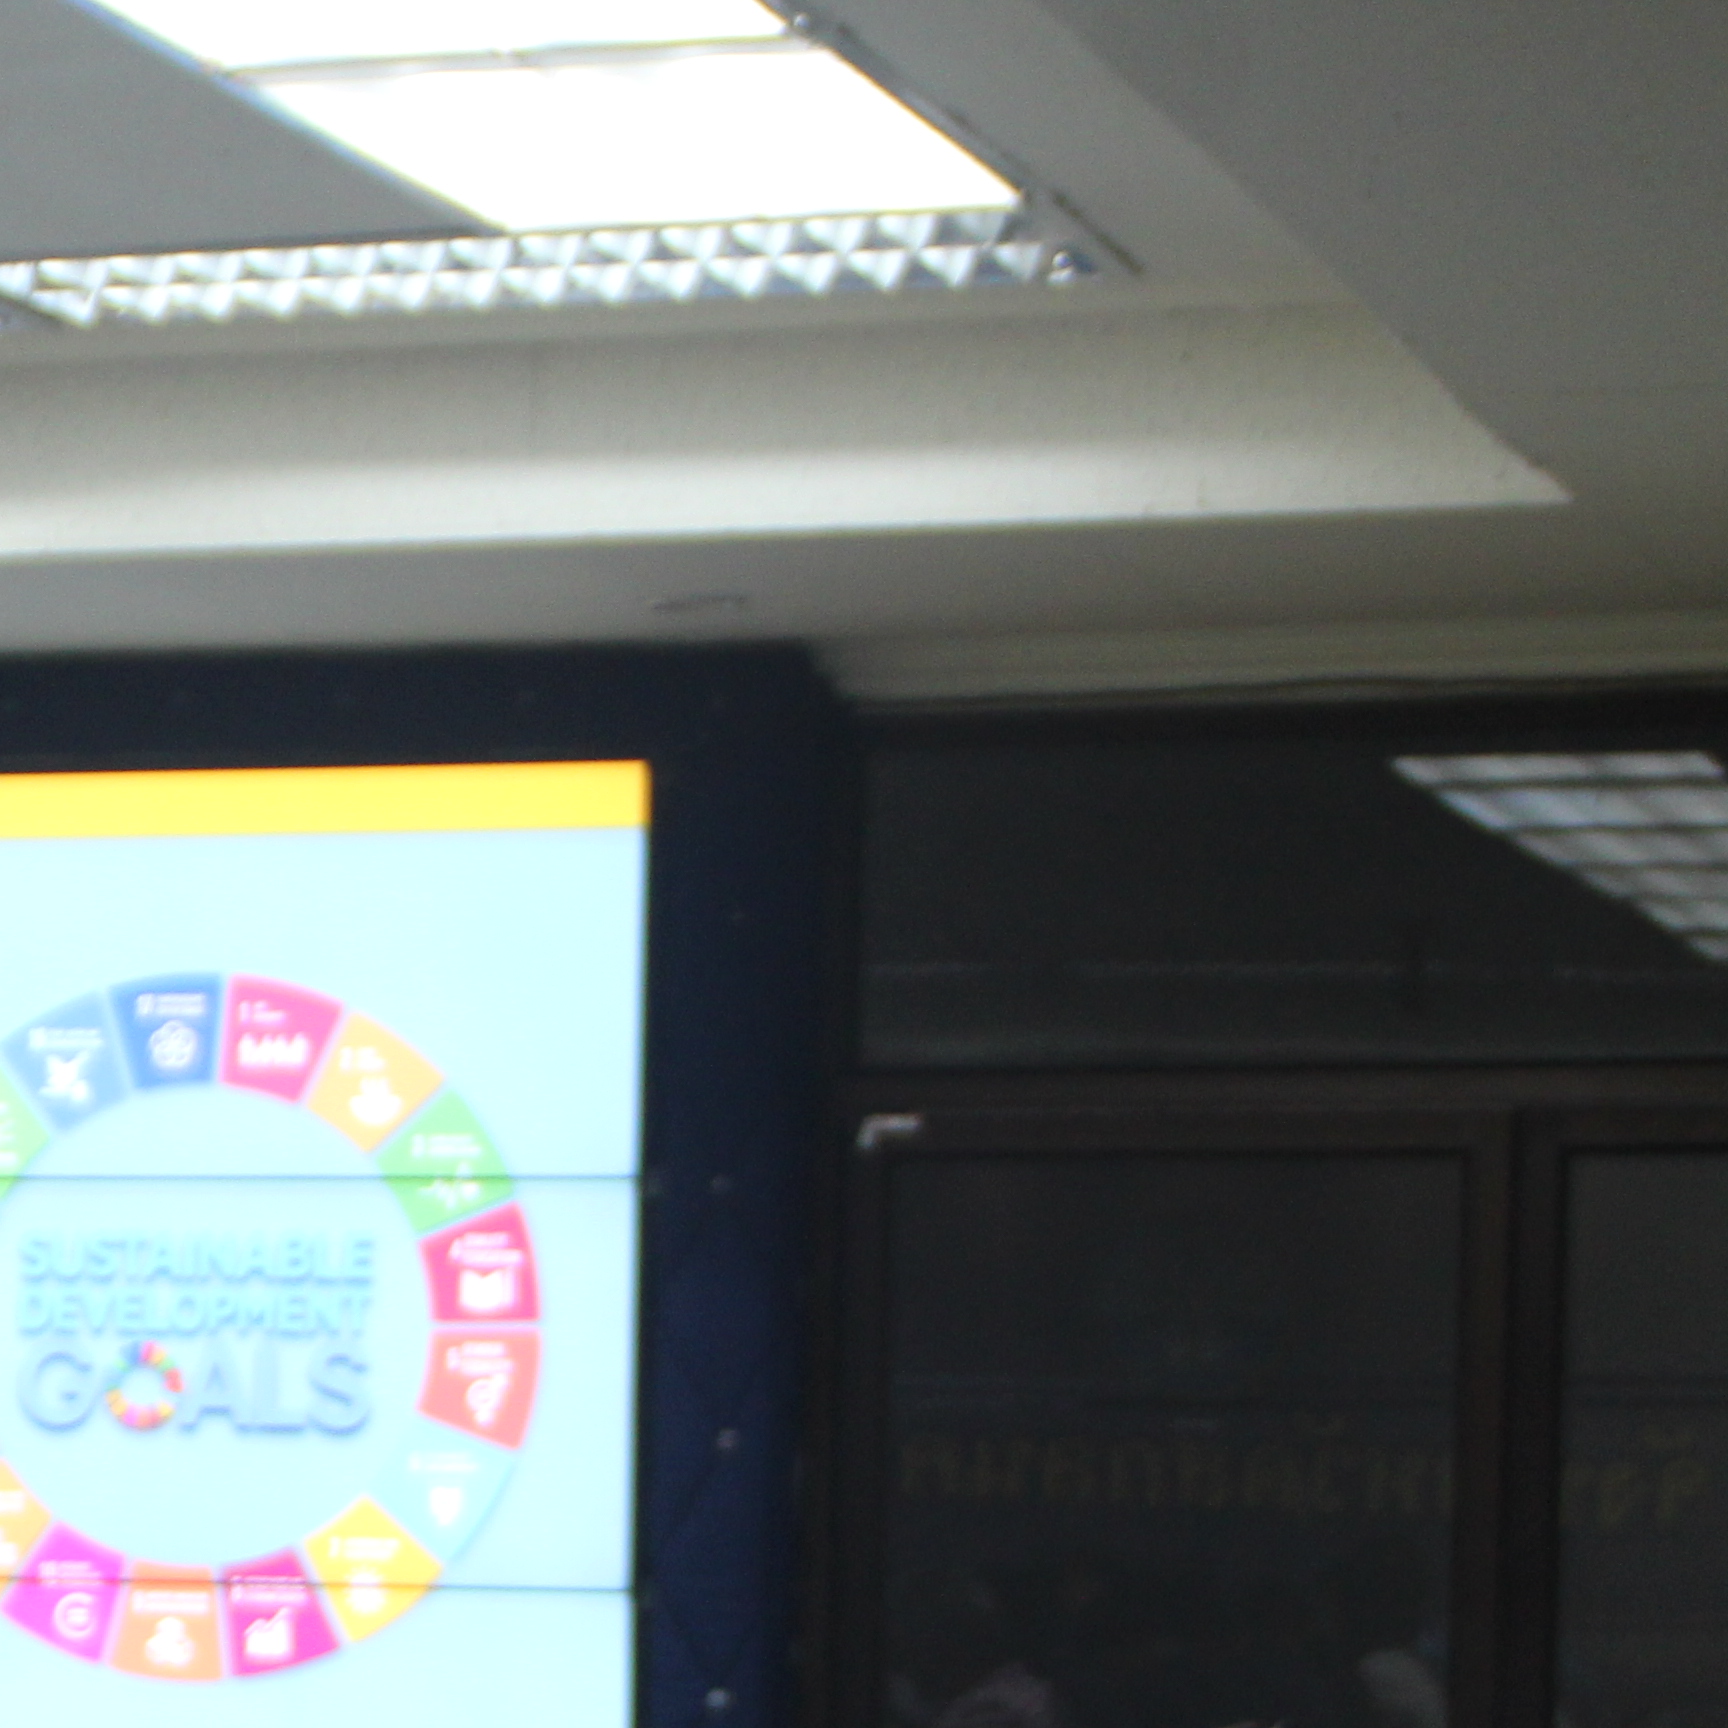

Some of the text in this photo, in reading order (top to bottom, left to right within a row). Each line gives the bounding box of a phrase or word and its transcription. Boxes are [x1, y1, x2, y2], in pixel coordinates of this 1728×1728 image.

[19, 1236, 373, 1284] SUSTAINABLE
[19, 1293, 372, 1337] DEVELOPMENT
[19, 1341, 372, 1435] GOALS
